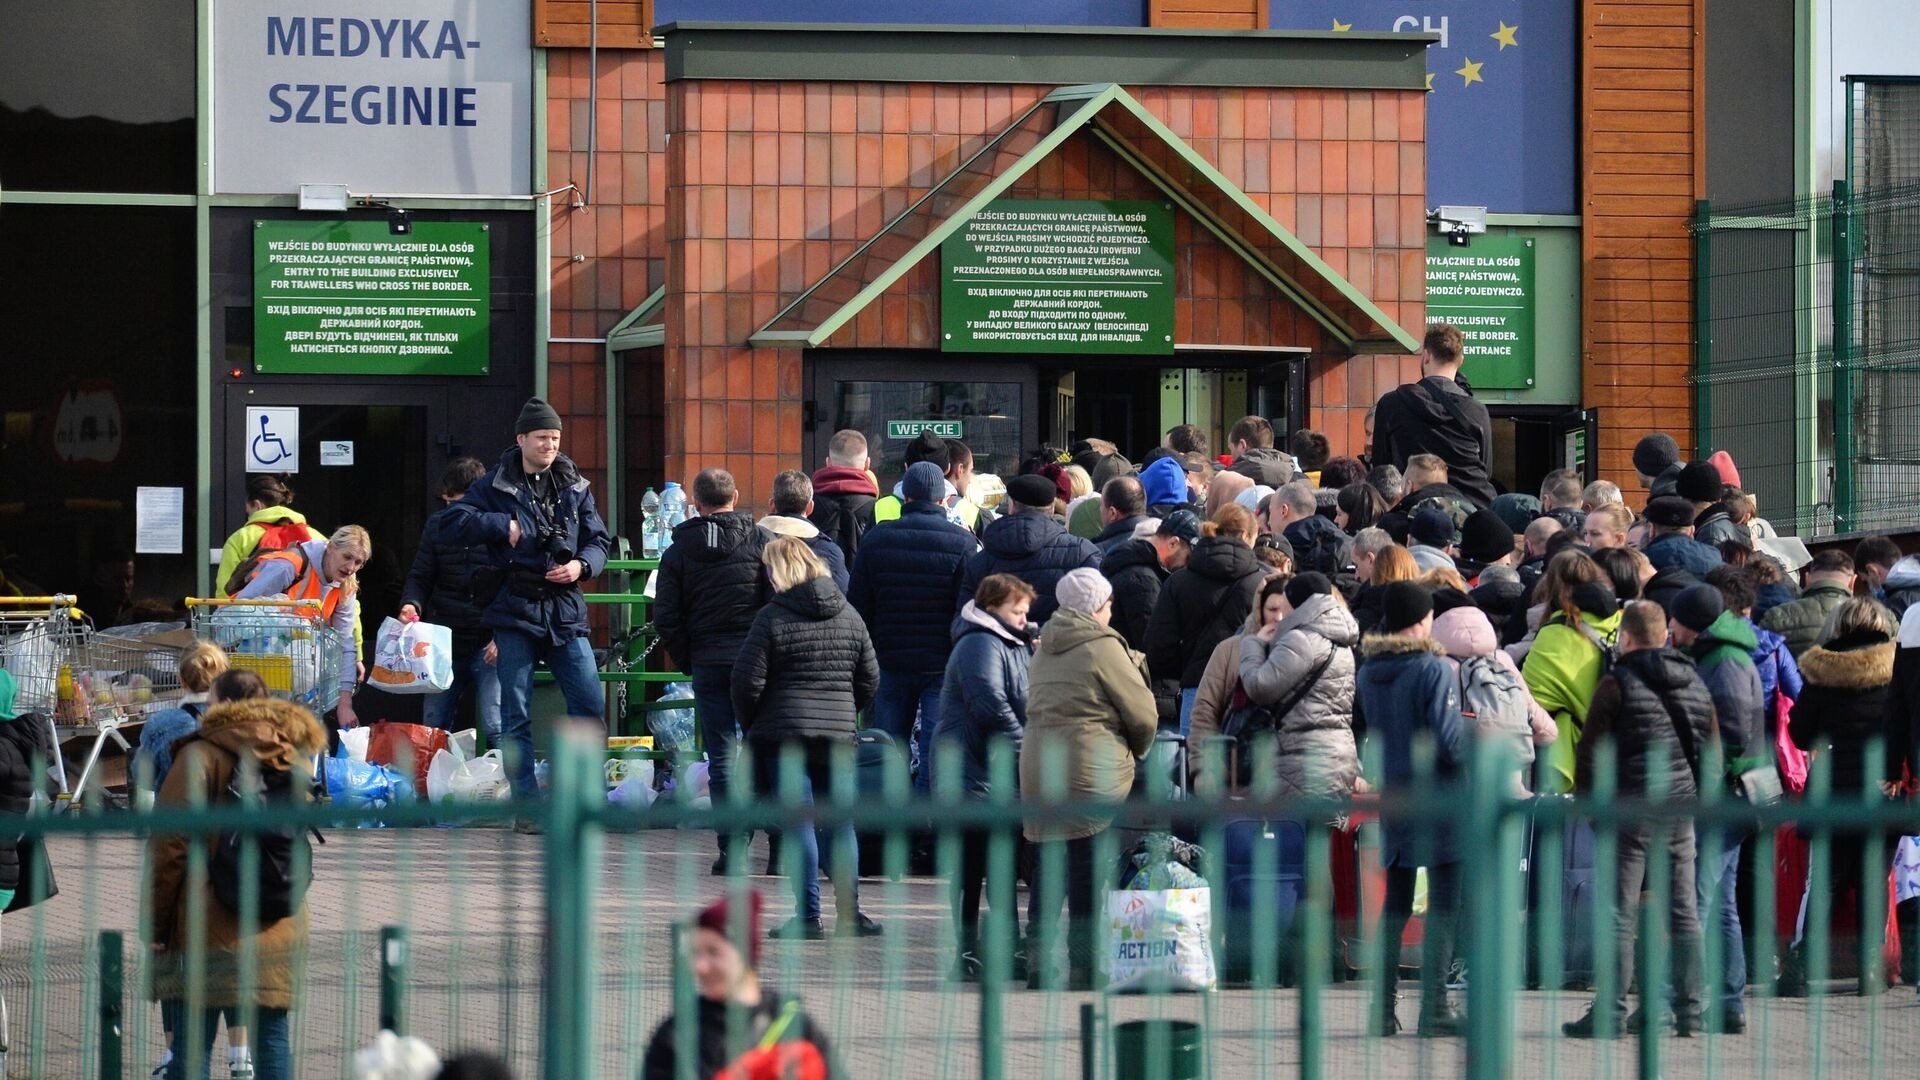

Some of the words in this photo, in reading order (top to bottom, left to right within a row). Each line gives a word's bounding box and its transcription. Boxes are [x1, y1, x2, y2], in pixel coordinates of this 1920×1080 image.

[267, 16, 480, 60] MEDYKA-
[269, 83, 477, 127] SZEGINIE
[1006, 212, 1017, 221] DO
[1019, 212, 1058, 221] BUDYNKU
[1059, 213, 1106, 224] WYŁĄCZNIE
[1107, 213, 1124, 222] DLA
[1125, 212, 1146, 222] OSÓB
[970, 223, 1053, 234] PRZEKRACZAJĄCYCH
[1054, 224, 1090, 234] GRANICĘ
[1092, 223, 1146, 235] PAŃSTWOWĄ.
[966, 233, 977, 242] DO
[978, 232, 1015, 242] WEJŚCIA
[1016, 234, 1052, 243] PROSIMY
[1053, 233, 1095, 243] WCHODZIĆ
[1096, 235, 1150, 244] POJEDYNCZO.
[268, 240, 310, 251] WEJŚCIE
[312, 242, 325, 251] DO
[326, 242, 372, 252] BUDYNKU
[373, 242, 428, 253] WYŁĄCZNIE
[429, 243, 448, 253] DLA
[449, 241, 474, 253] OSÓB
[975, 244, 983, 252] W
[984, 244, 1032, 253] PRZYPADKU
[1034, 244, 1065, 254] DUŻEGO
[1067, 244, 1099, 254] BAGAŻU
[269, 254, 366, 266] PRZEKRACZAJĄCYCH
[367, 255, 409, 267] GRANICĘ
[411, 254, 474, 268] PAŃSTWOWĄ.
[986, 255, 1022, 264] PROSIMY
[1024, 256, 1030, 264] O
[1031, 256, 1086, 265] KORZYSTANIE
[1087, 257, 1093, 265] Z
[1094, 255, 1129, 266] WEJŚCIA
[1477, 257, 1495, 266] DLA
[1496, 255, 1521, 266] OSÓB
[284, 267, 315, 276] ENTRY
[317, 267, 329, 277] TO
[330, 267, 350, 277] THE
[351, 268, 396, 278] BUILDING
[398, 268, 459, 278] EXCLUSIVELY
[953, 266, 1027, 275] PRZEZNACZONEGO
[1028, 267, 1045, 275] DLA
[1046, 265, 1068, 276] OSÓB
[1069, 267, 1162, 277] NIEPEŁNOSPRAWNYCH.
[1459, 269, 1520, 282] PAŃSTWOWĄ.
[271, 279, 290, 289] FOR
[291, 280, 354, 290] TRAWELLERS
[355, 281, 378, 290] WHO
[379, 281, 410, 291] CROSS
[411, 281, 430, 291] THE
[432, 281, 472, 291] BORDER.
[968, 287, 988, 297] ВХІД
[989, 288, 1032, 297] ВІКЛЮЧНО
[1033, 289, 1051, 298] ДЛЯ
[1052, 289, 1071, 298] ОСІБ
[1073, 289, 1086, 298] ЯКІ
[1088, 289, 1148, 298] ПЕРЕТИНАЮТЬ
[1464, 287, 1525, 297] POJEDYNCZO.
[1013, 299, 1066, 309] ДЕРЖАВНИЙ
[1067, 300, 1102, 310] КОРДОН.
[267, 305, 290, 316] ВХІД
[291, 305, 342, 315] ВІКЛЮЧНО
[343, 306, 364, 317] ДЛЯ
[365, 306, 387, 316] ОСІБ
[389, 306, 405, 316] ЯКІ
[407, 306, 476, 317] ПЕРЕТИНАЮТЬ
[988, 310, 1000, 319] ДО
[1002, 310, 1029, 320] ВХОДУ
[1031, 310, 1077, 320] ПІДХОДИТИ
[1079, 311, 1090, 320] ПО
[1091, 311, 1127, 321] ОДНОМУ.
[320, 317, 381, 329] ДЕРЖАВНИЙ
[383, 319, 423, 330] КОРДОН.
[967, 320, 972, 329] У
[974, 320, 1013, 330] ВИПАДКУ
[1014, 321, 1056, 330] ВЕЛИКОГО
[1058, 321, 1091, 330] БАГАЖУ
[1094, 322, 1149, 332] (ВЕЛОСИПЕД)
[1446, 316, 1506, 325] EXCLUSIVELY
[284, 330, 314, 341] ДВЕРІ
[315, 331, 352, 342] БУДУТЬ
[353, 331, 408, 343] ВІДЧИНЕНІ,
[409, 332, 423, 342] ЯК
[424, 332, 458, 342] ТІЛЬКИ
[1058, 332, 1077, 342] ВХІД
[1080, 333, 1098, 342] ДЛЯ
[1099, 333, 1143, 343] ІНВАЛІДІВ.
[1479, 331, 1519, 341] BORDER.
[291, 343, 358, 354] НАТИСНЕТЬСЯ
[359, 344, 397, 354] КНОПКУ
[398, 345, 453, 355] ДЗВОНИКА.
[1463, 346, 1512, 355] ENTRANCE
[1118, 940, 1177, 959] ACTION
